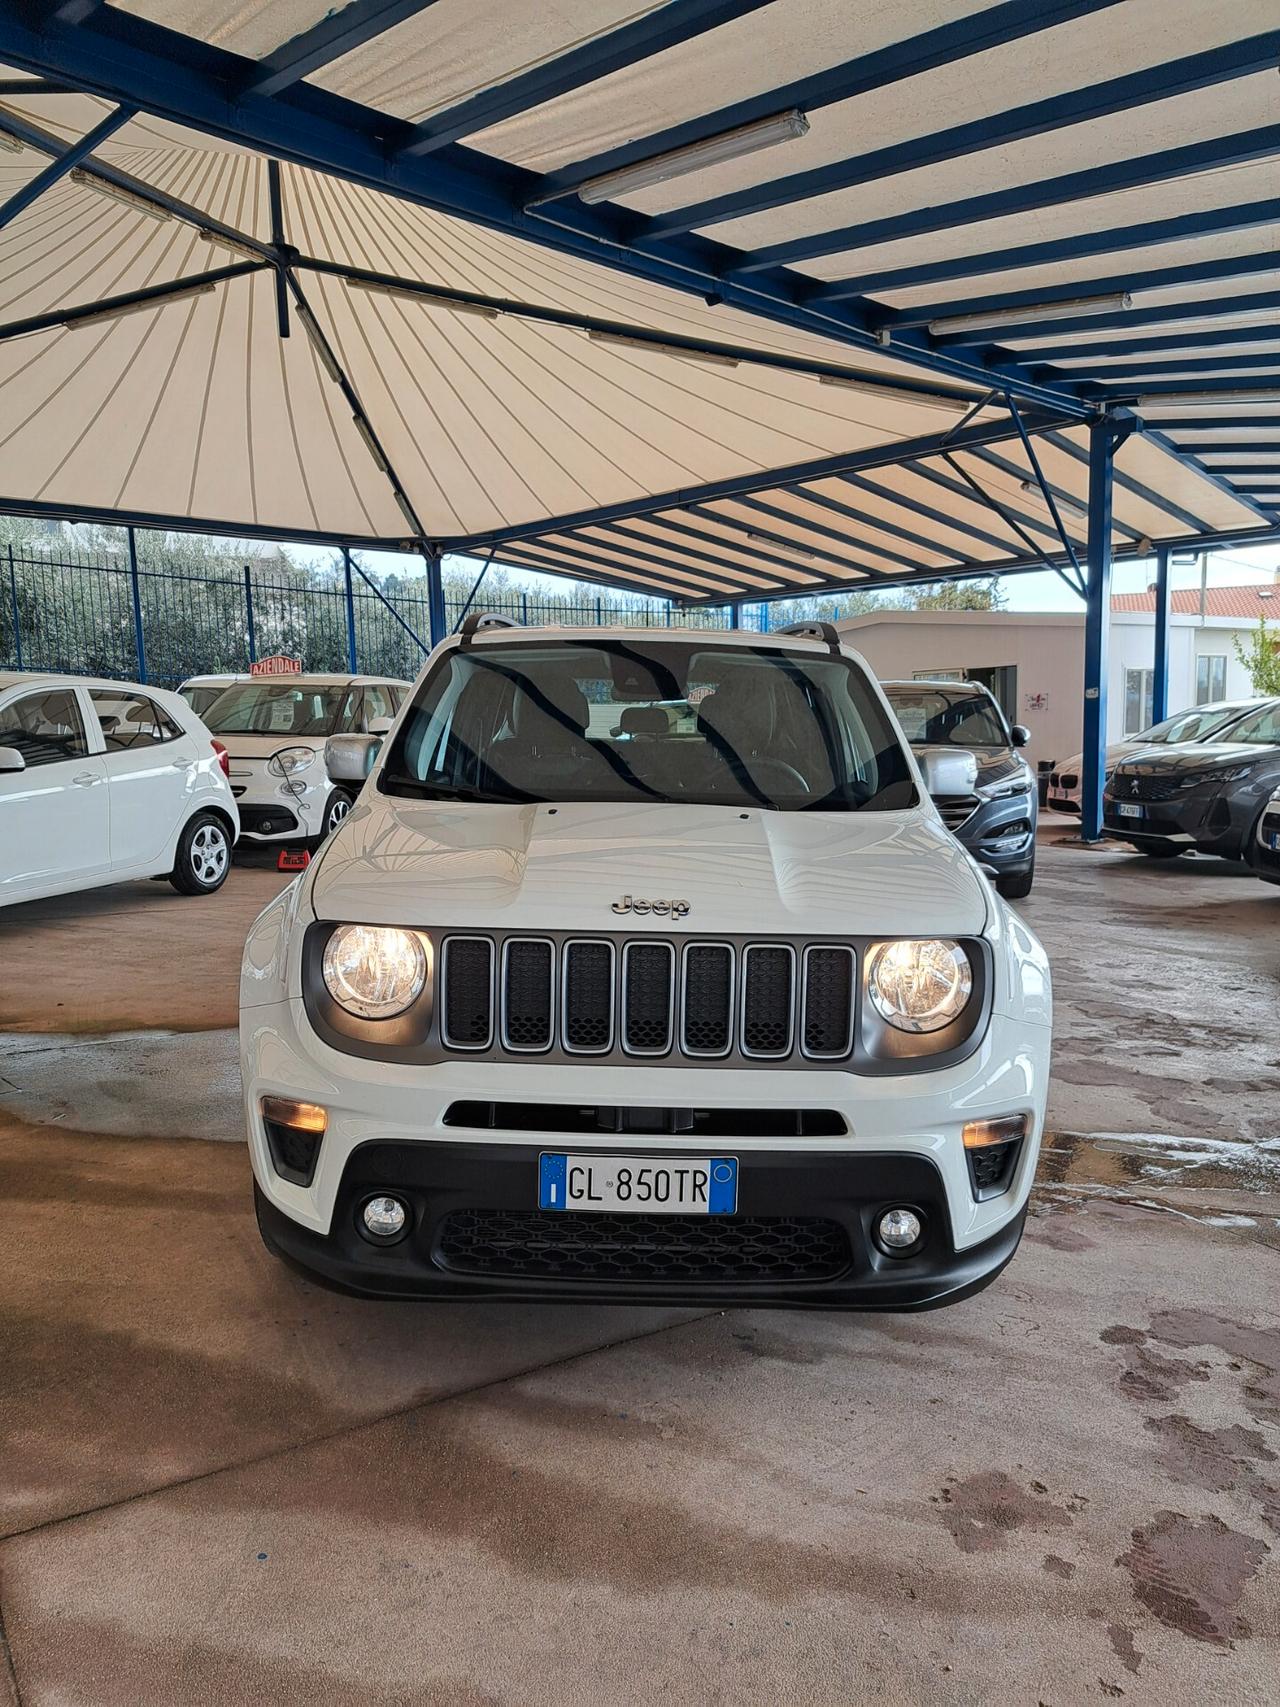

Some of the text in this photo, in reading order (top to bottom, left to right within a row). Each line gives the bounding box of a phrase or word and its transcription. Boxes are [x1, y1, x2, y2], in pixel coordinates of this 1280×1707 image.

[253, 657, 299, 675] AZIENDALE
[611, 895, 690, 920] Jeep
[568, 1166, 603, 1201] GL
[615, 1167, 709, 1203] 850TR
